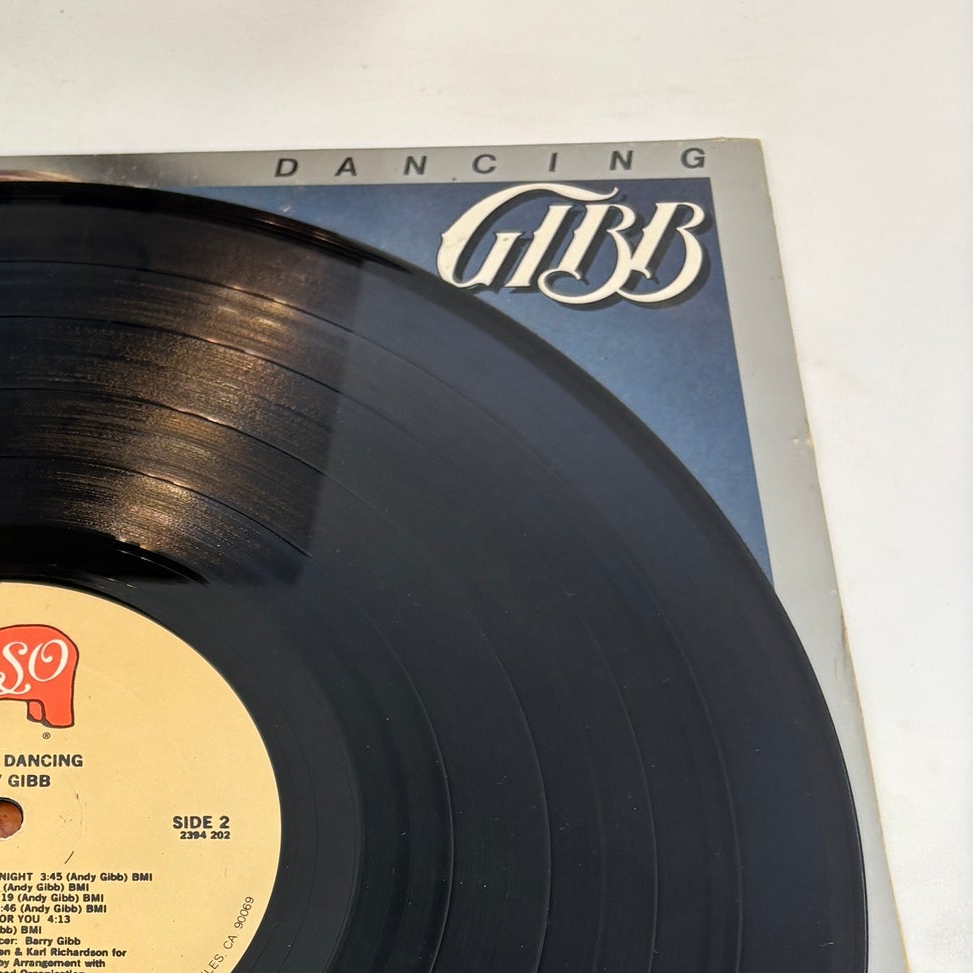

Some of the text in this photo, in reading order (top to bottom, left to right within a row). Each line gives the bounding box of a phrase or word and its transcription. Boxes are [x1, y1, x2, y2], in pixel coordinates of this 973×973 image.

[274, 147, 711, 178] DANCING
[435, 182, 705, 304] GIBB
[4, 754, 83, 767] DANCING
[8, 774, 51, 787] GIBB
[172, 815, 230, 829] SIDE 2
[180, 831, 231, 839] 2394 202
[40, 872, 63, 881] 3:45
[66, 873, 96, 883] (Andy
[100, 873, 128, 882] Gibb)
[132, 873, 153, 881] BMI
[3, 883, 33, 893] (Andy
[36, 883, 65, 892] Gibb)
[69, 883, 89, 891] BMI
[17, 894, 47, 903] (Andy
[51, 894, 79, 903] Gibb)
[83, 894, 104, 902] BMI
[20, 904, 50, 914] (Andy
[53, 904, 82, 914] Gibb)
[86, 905, 107, 913] BMI
[234, 896, 255, 930] 90069
[18, 915, 40, 923] YOU
[47, 915, 71, 923] 4:13
[21, 926, 42, 934] BMI
[25, 937, 53, 946] Barry
[57, 937, 81, 945] Gibb
[15, 948, 23, 956] &
[26, 948, 46, 956] Karl
[50, 948, 108, 956] Richardson
[112, 948, 127, 957] for
[13, 959, 81, 968] Arrangement
[85, 959, 106, 967] with
